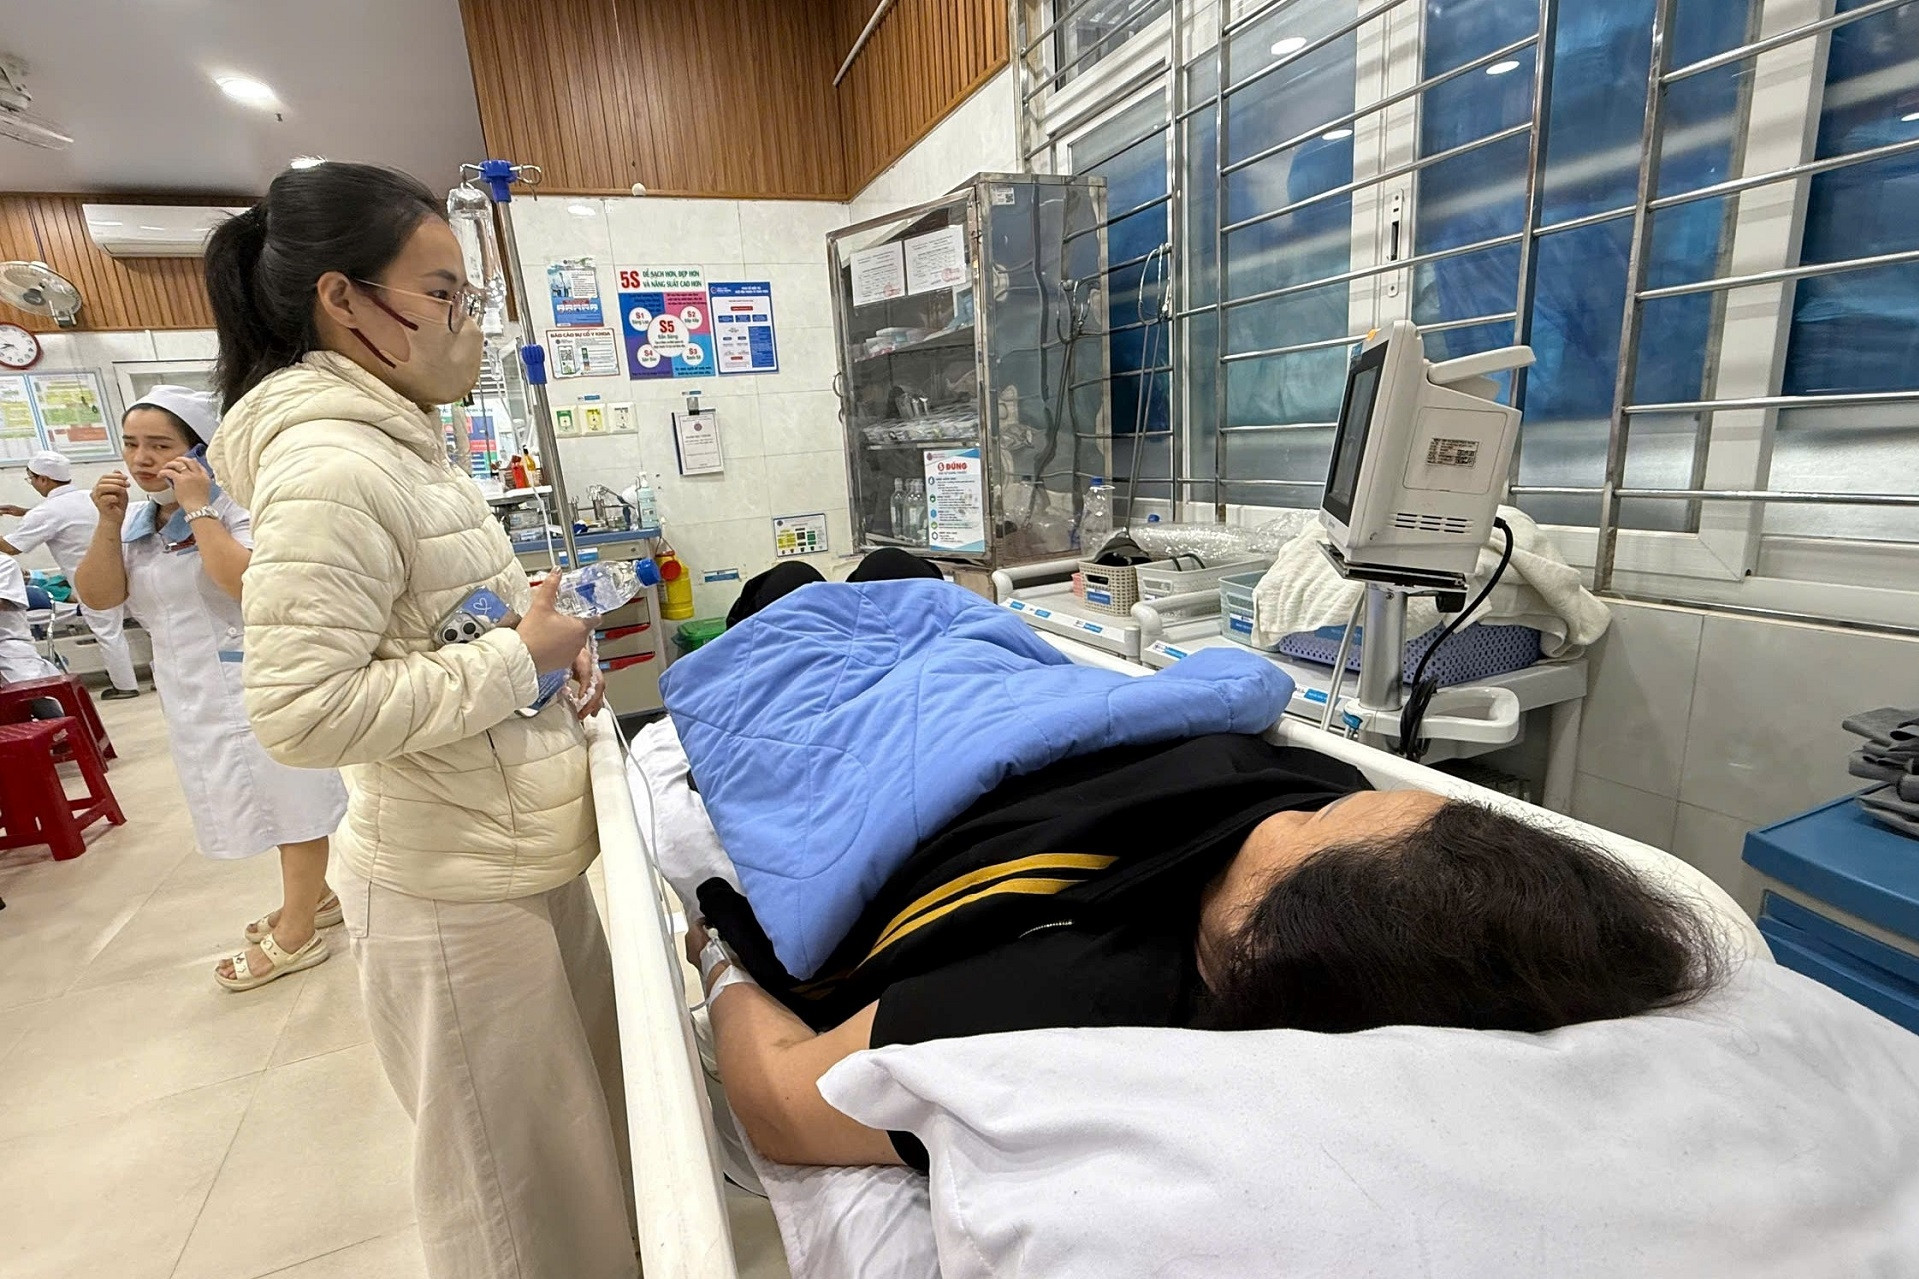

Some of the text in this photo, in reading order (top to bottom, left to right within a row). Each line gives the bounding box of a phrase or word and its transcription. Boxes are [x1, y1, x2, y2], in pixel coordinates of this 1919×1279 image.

[620, 271, 640, 288] 5S
[659, 320, 675, 333] S5
[945, 461, 967, 470] ĐÚNG
